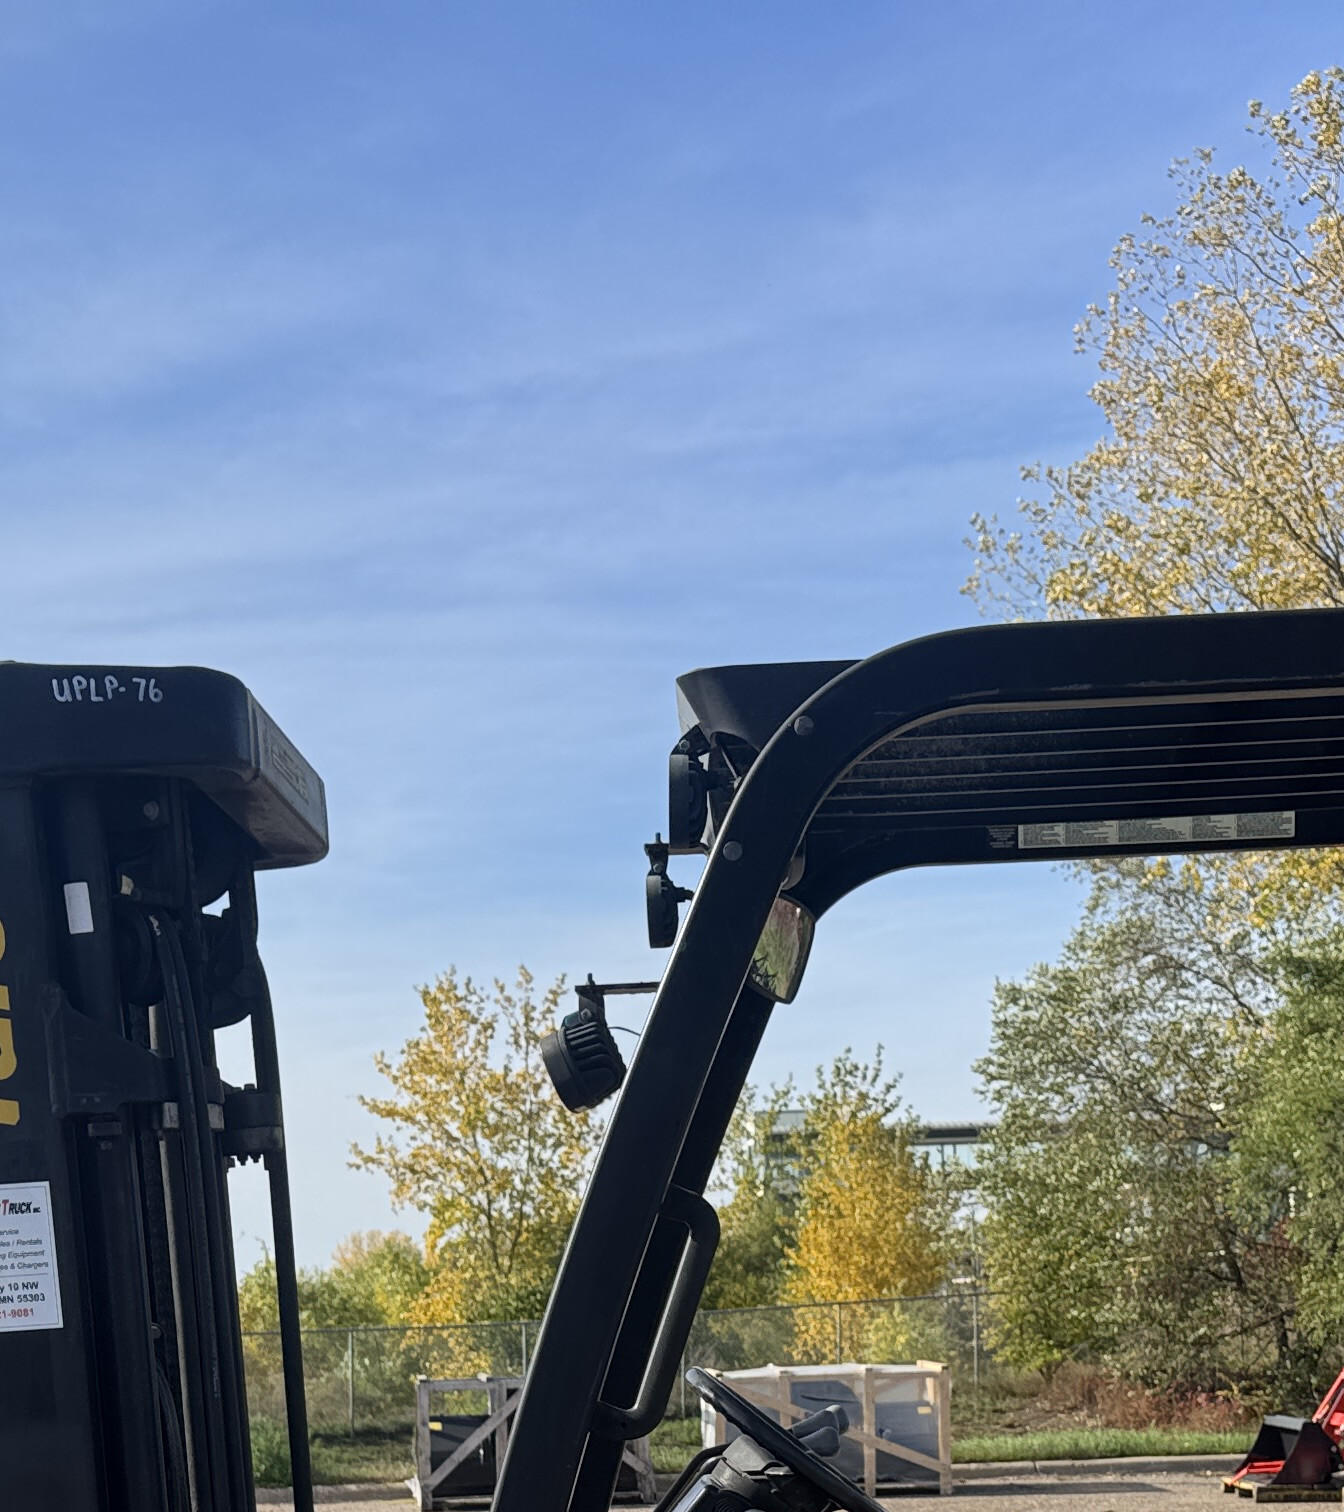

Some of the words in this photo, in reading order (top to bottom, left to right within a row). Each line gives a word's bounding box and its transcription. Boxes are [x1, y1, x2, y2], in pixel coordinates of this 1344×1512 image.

[8, 1282, 19, 1291] 10
[22, 1281, 39, 1290] NW
[17, 1293, 45, 1303] 55303
